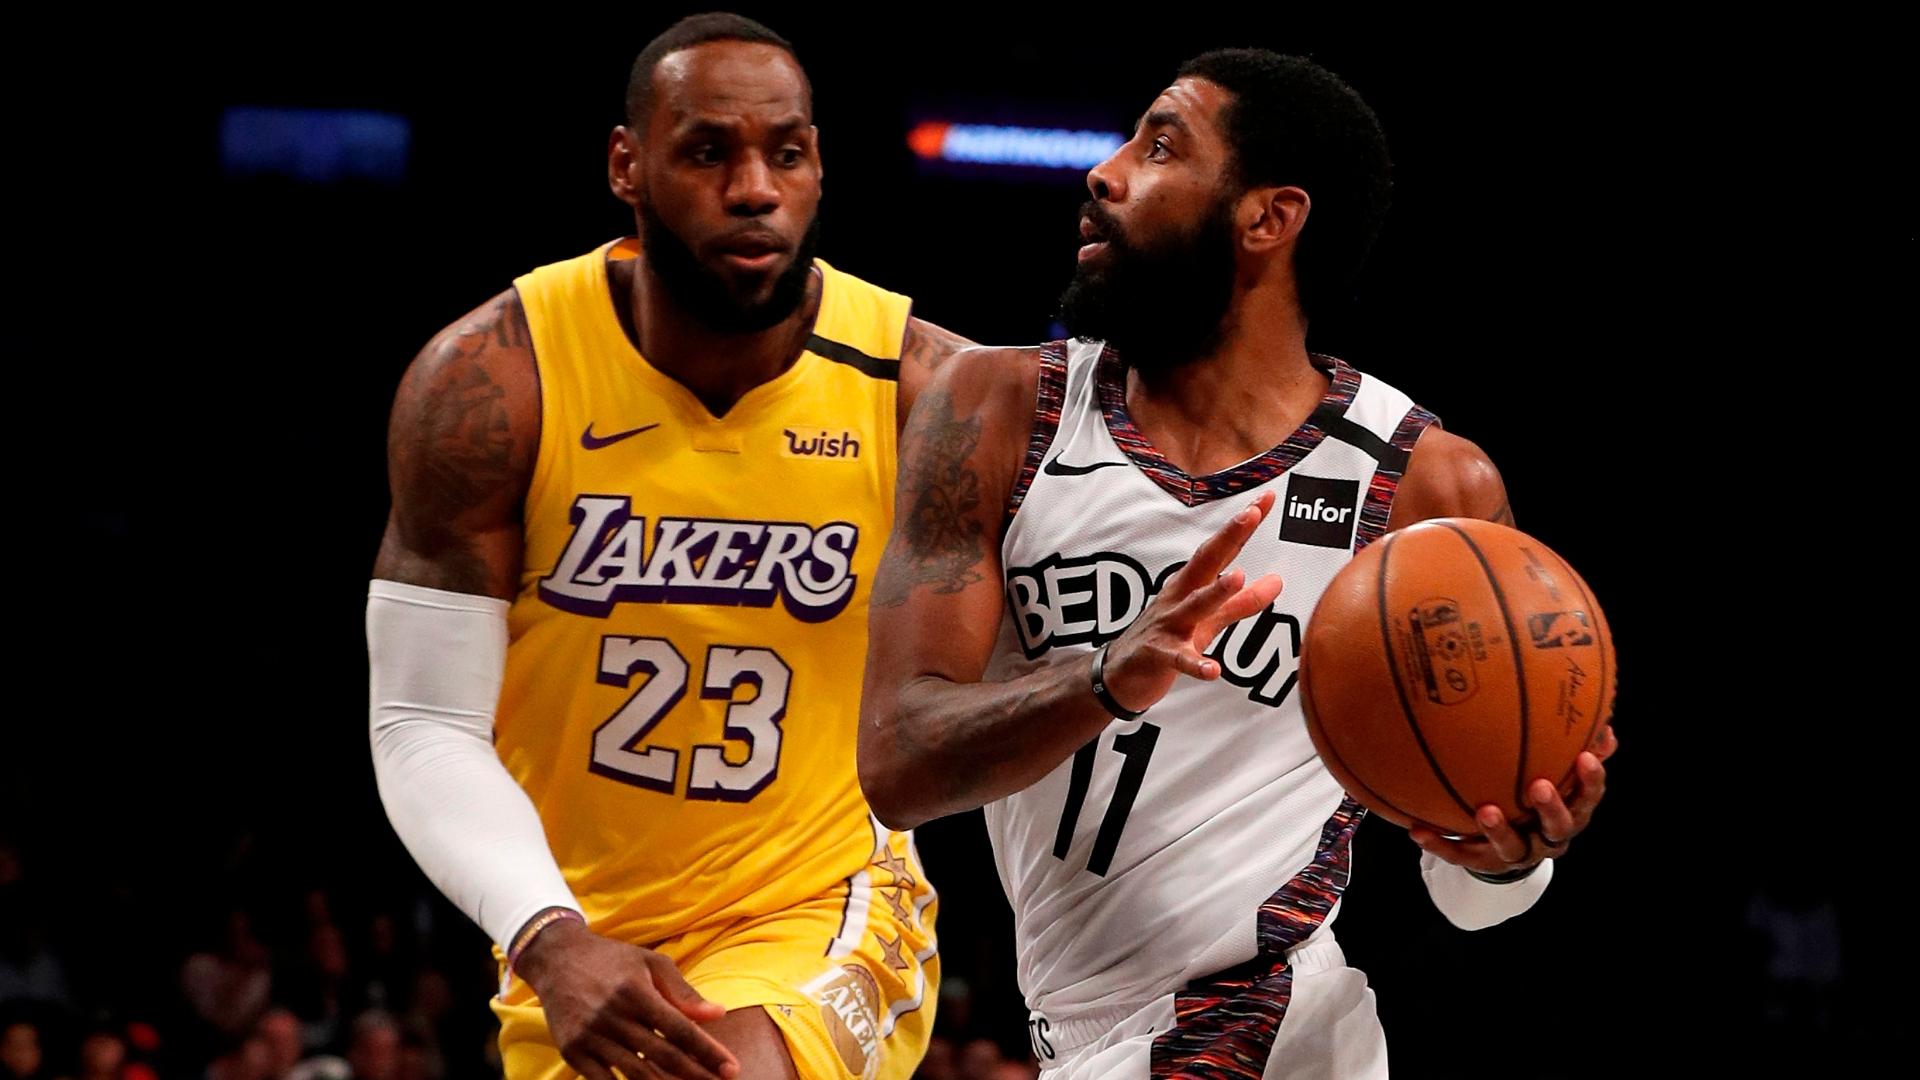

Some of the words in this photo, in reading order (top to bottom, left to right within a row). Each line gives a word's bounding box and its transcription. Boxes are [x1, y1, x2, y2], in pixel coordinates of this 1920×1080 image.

[784, 430, 860, 458] wish
[1288, 494, 1352, 524] infor
[538, 494, 860, 624] LAKERS
[588, 635, 793, 802] 23
[1053, 721, 1162, 878] 11
